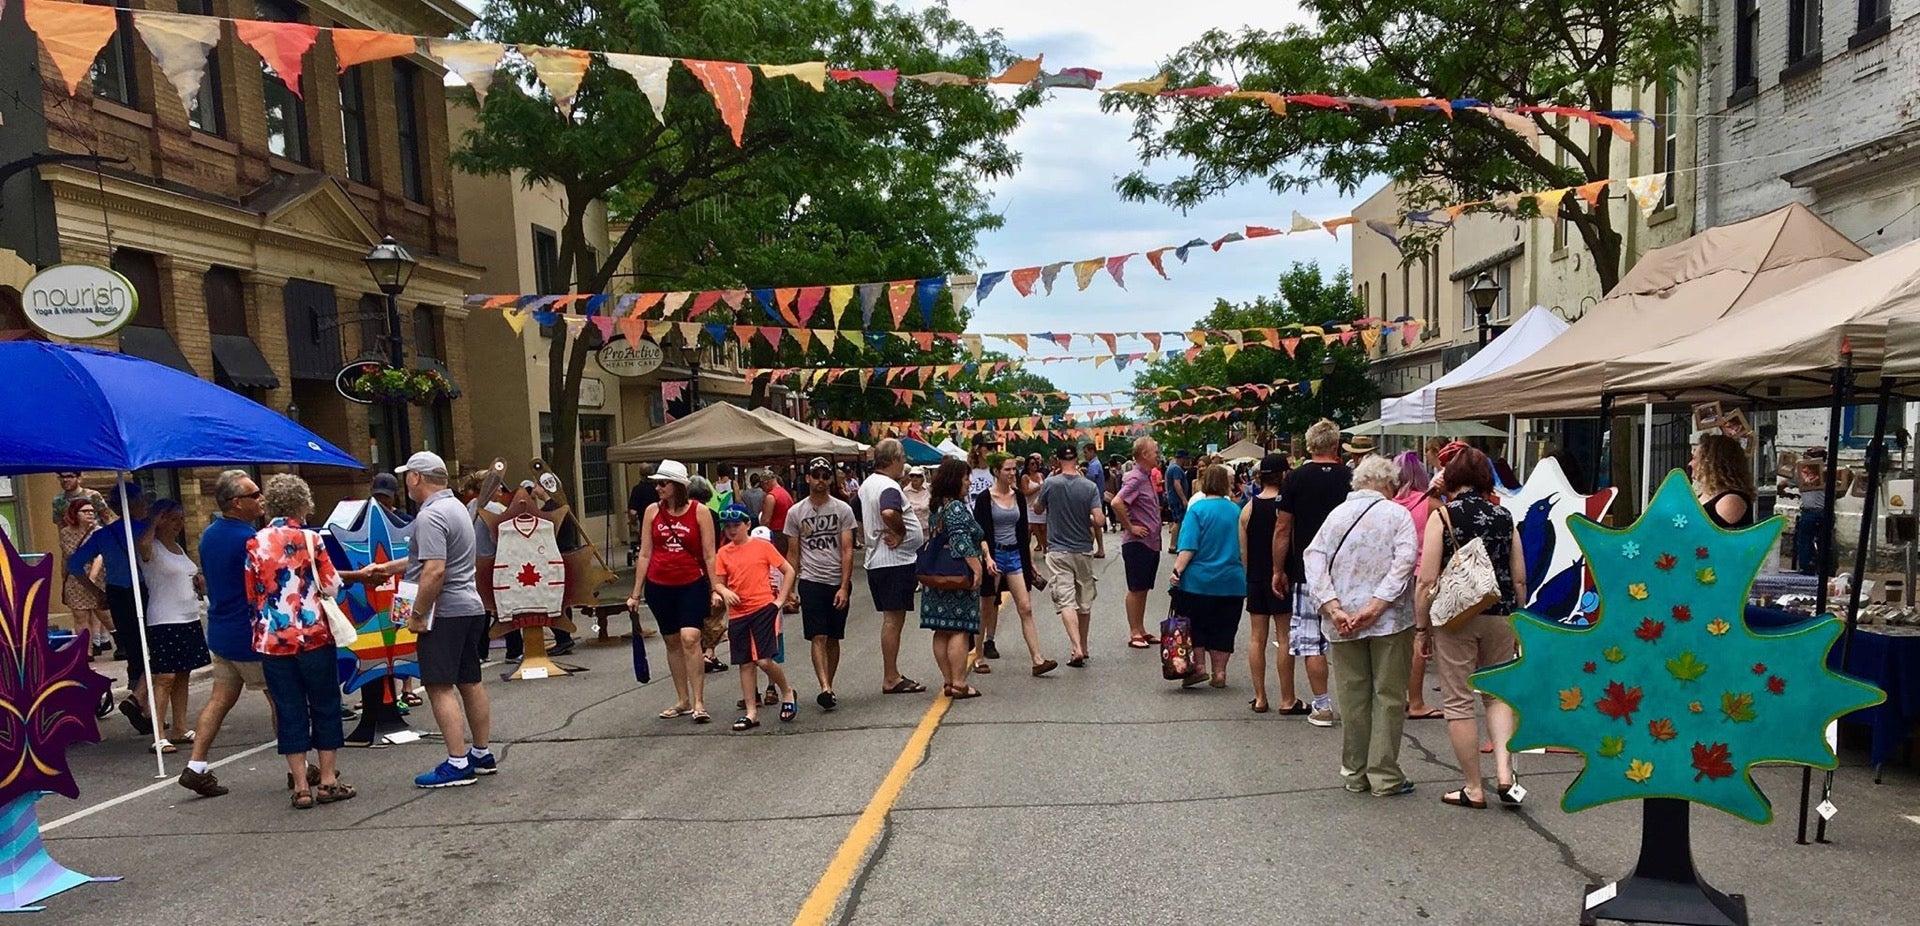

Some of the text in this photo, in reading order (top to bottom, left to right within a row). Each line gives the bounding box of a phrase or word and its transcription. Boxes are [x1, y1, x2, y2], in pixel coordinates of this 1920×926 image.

[33, 281, 125, 309] nourish
[35, 305, 118, 317] Yoga & Wellness Studio
[602, 345, 660, 359] ProActive
[807, 536, 838, 551] COM
